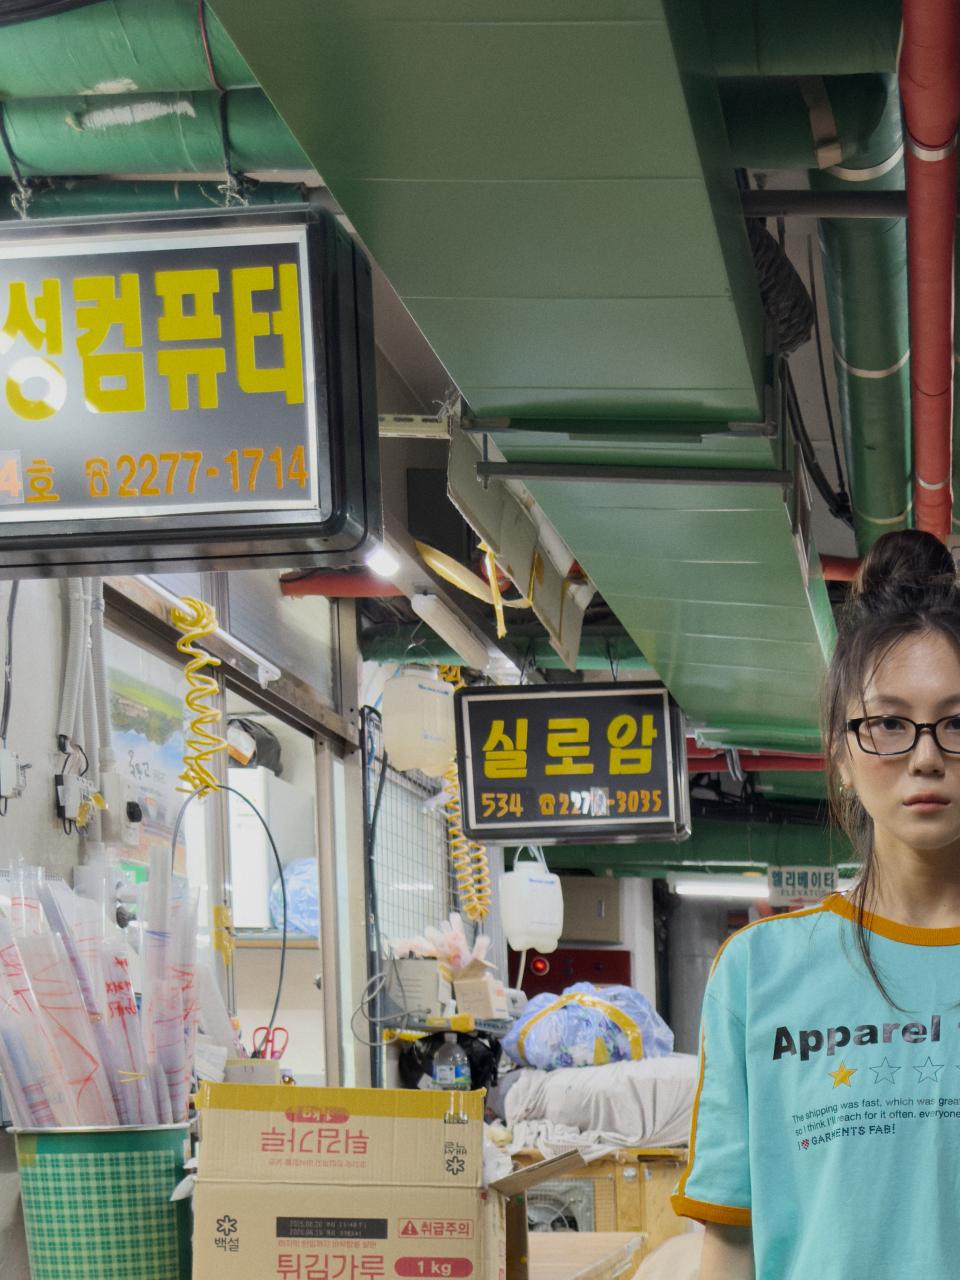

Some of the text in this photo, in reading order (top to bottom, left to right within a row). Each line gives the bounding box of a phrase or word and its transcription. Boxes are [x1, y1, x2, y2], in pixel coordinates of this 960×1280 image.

[2, 263, 304, 421] 성컴퓨터
[117, 445, 308, 498] 2277-1714
[481, 713, 658, 779] 실로암
[481, 792, 523, 817] 534
[772, 870, 835, 888] 엘리베이터
[773, 1015, 941, 1061] Apparel
[792, 1114, 805, 1124] The
[805, 1103, 838, 1119] shipping
[840, 1101, 859, 1109] was
[885, 1097, 914, 1107] which
[916, 1098, 935, 1106] was
[795, 1128, 803, 1137] so
[807, 1119, 825, 1132] think
[827, 1117, 836, 1128] I'll
[864, 1111, 878, 1120] for
[880, 1110, 886, 1119] it
[919, 1109, 960, 1119] everyone
[811, 1126, 866, 1146] GARMENTS
[869, 1123, 896, 1135] FAB!
[421, 1222, 470, 1236] 취급주의
[214, 1237, 240, 1252] 백설
[276, 1254, 385, 1280] 튀김가루
[417, 1261, 452, 1275] 1 kg
